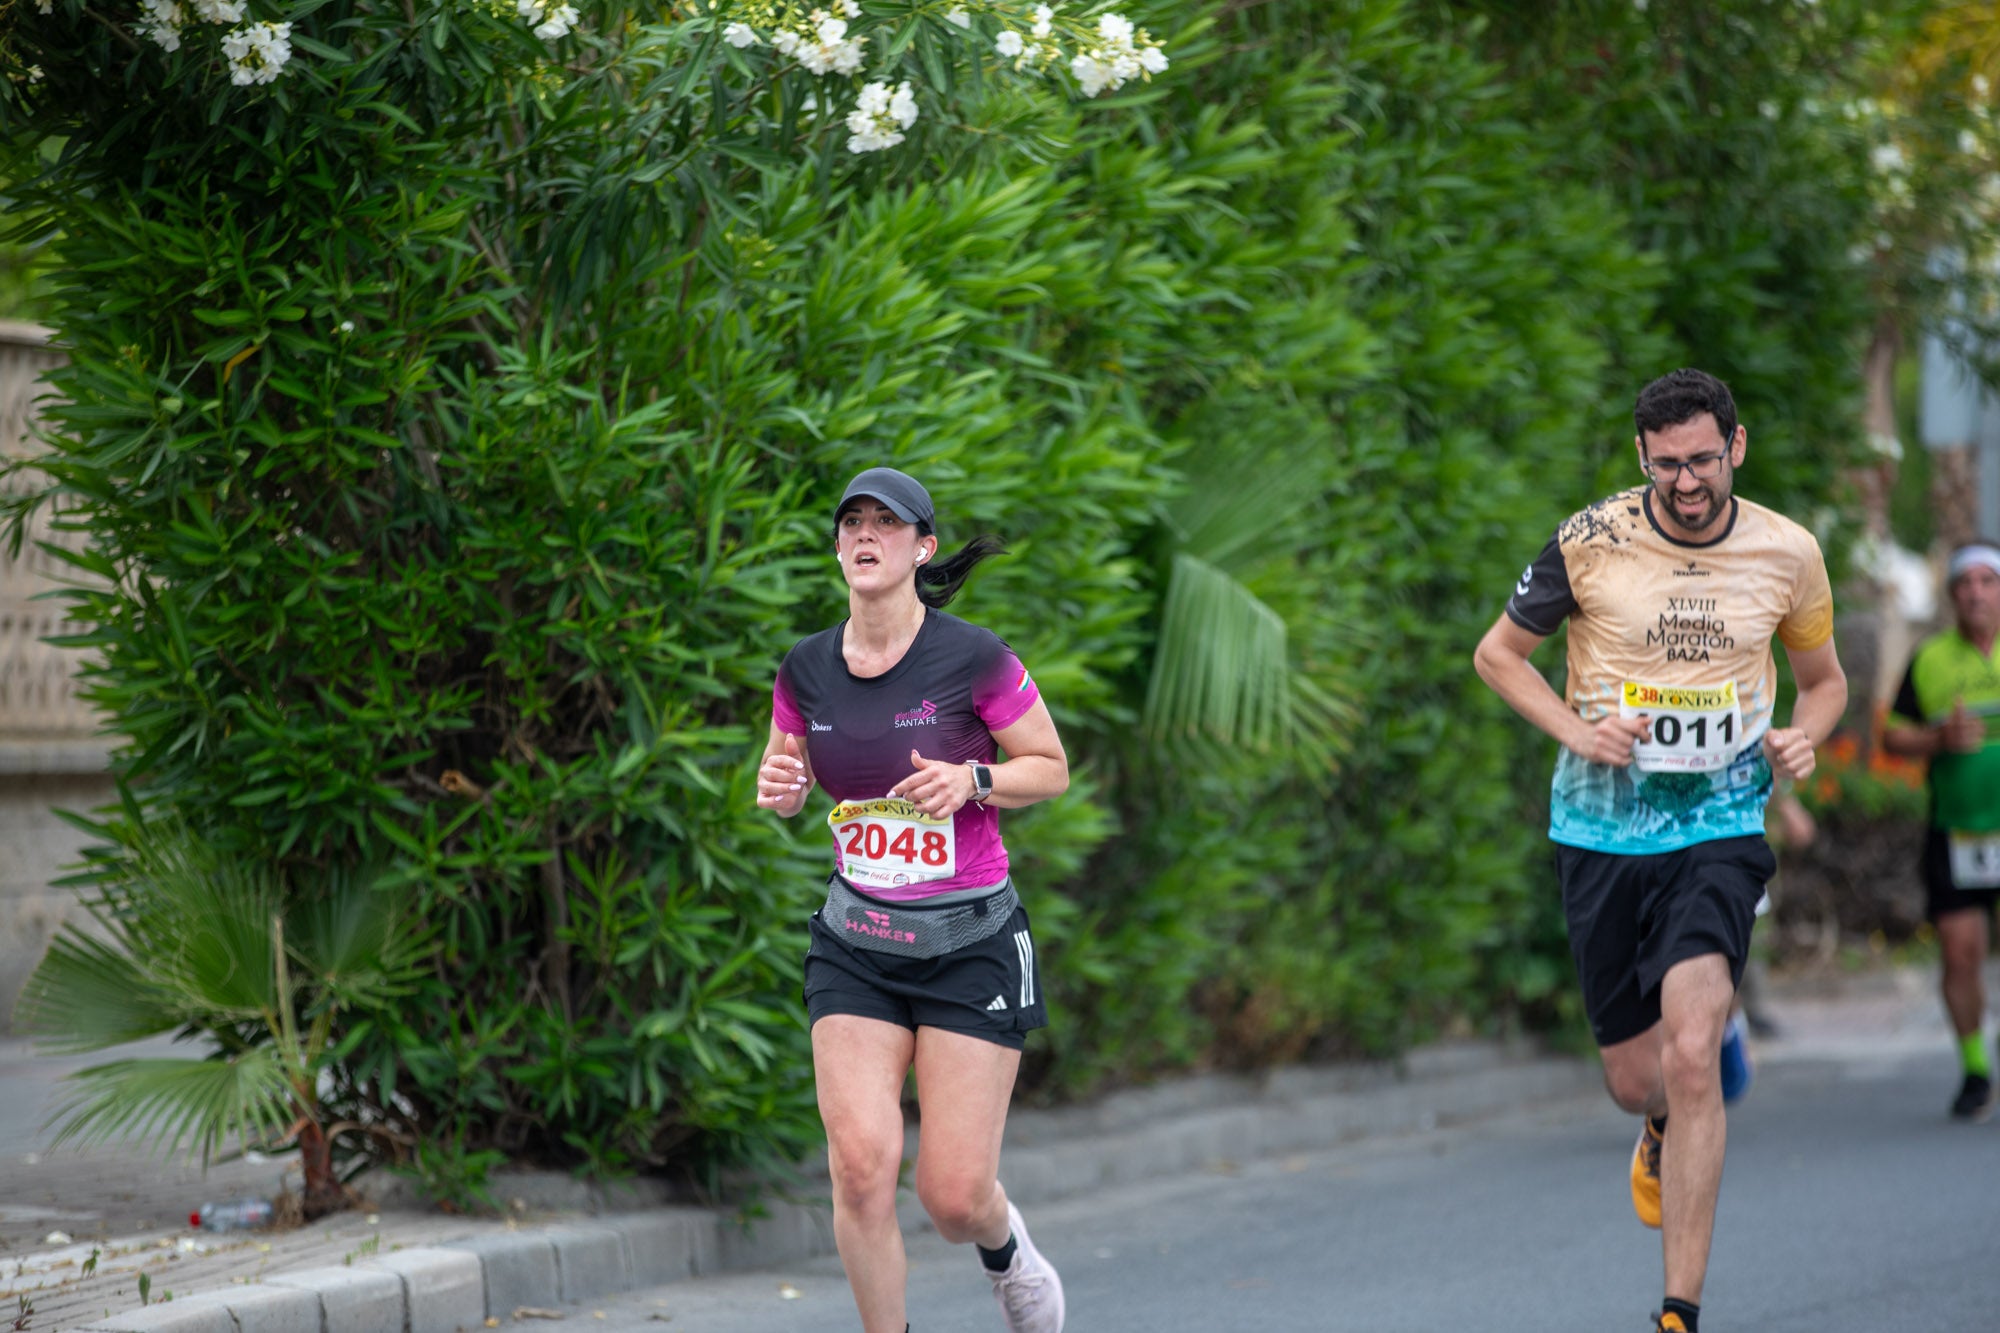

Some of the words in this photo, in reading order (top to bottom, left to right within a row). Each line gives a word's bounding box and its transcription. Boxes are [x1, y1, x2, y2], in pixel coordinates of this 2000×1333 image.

[1667, 597, 1716, 611] XLVIII
[1659, 613, 1724, 633] Media
[1667, 648, 1710, 662] BAZA
[1640, 688, 1657, 703] 38
[842, 806, 864, 818] 38
[840, 823, 948, 866] 2048
[846, 919, 917, 944] HANKER
